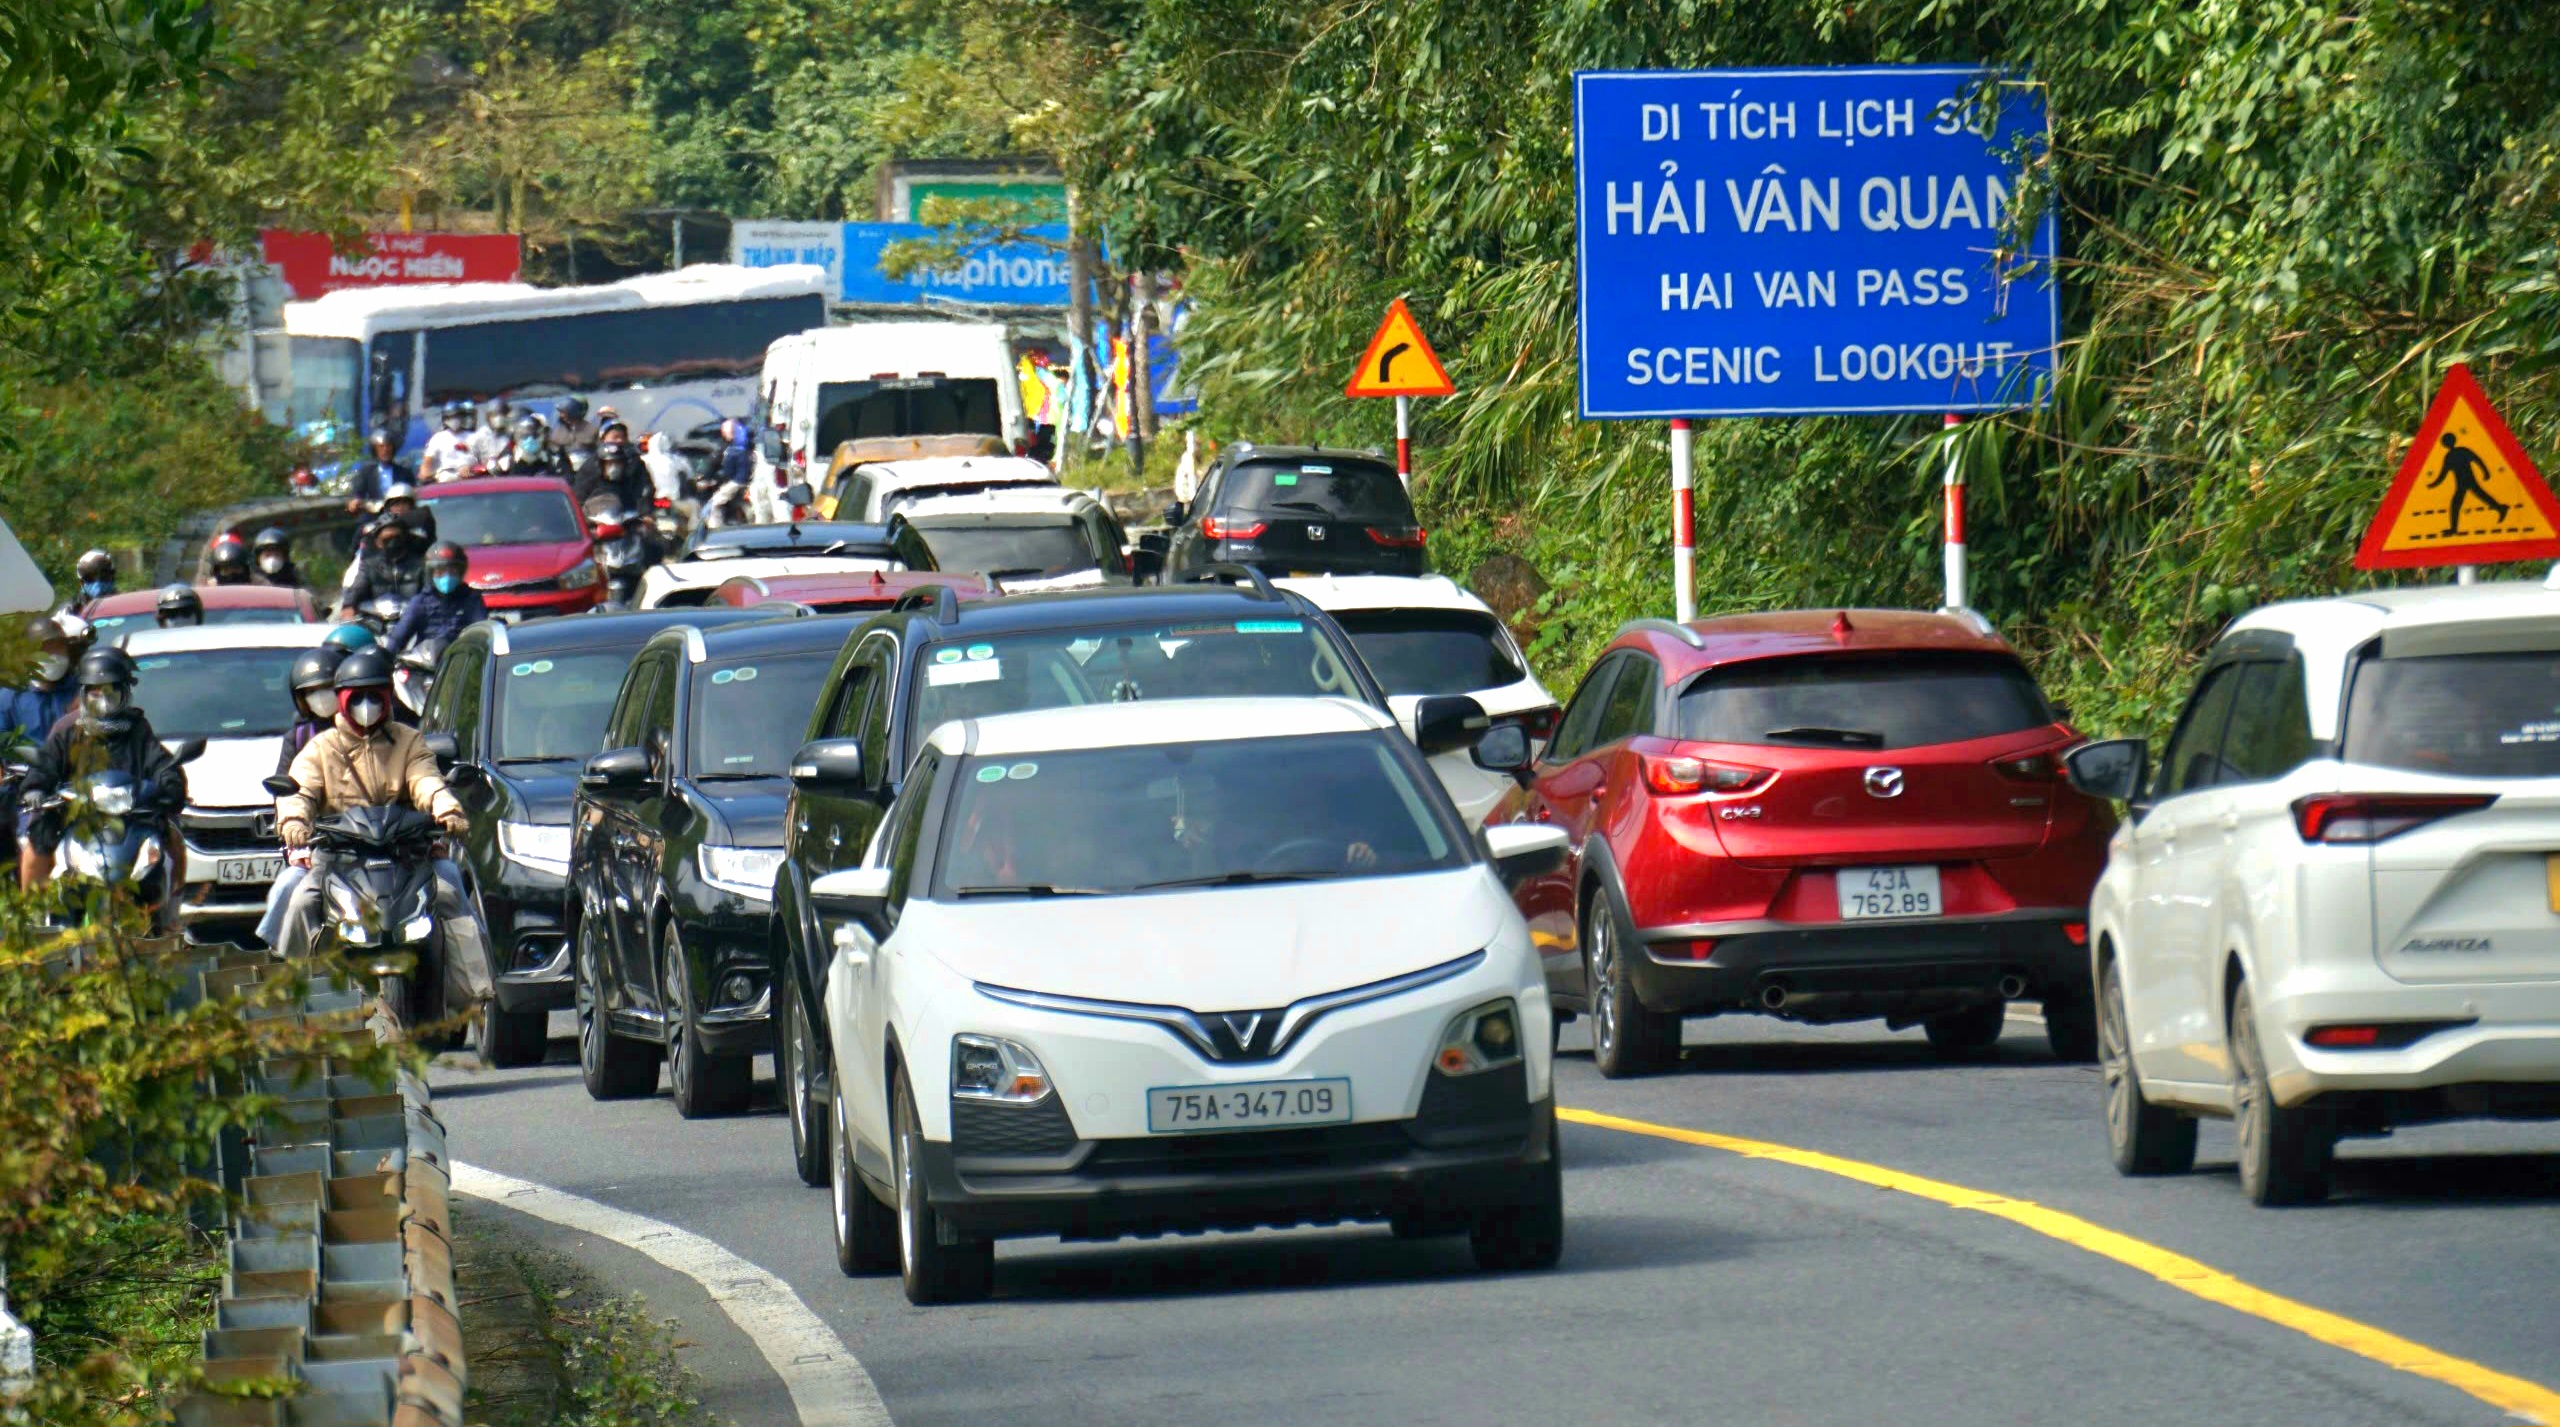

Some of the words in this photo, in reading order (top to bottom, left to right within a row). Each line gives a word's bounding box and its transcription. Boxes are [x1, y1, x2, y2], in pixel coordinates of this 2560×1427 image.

[1641, 102, 1681, 142] DI
[1699, 87, 1796, 141] TÍCH
[1818, 98, 1914, 148] LỊCH
[1606, 159, 1707, 236] HẢI
[1724, 162, 1841, 234] VÂN
[1858, 174, 2026, 232] QUAN
[1660, 272, 1734, 312] HAI
[1752, 270, 1837, 308] VAN
[1856, 267, 1970, 307] PASS
[1626, 345, 1782, 386] SCENIC
[1814, 341, 2014, 383] LOOKOUT
[1720, 805, 1762, 820] CX-3
[1868, 868, 1911, 891] 43A
[1851, 892, 1931, 916] 762.89
[1166, 1087, 1334, 1122] 75A-347.09
